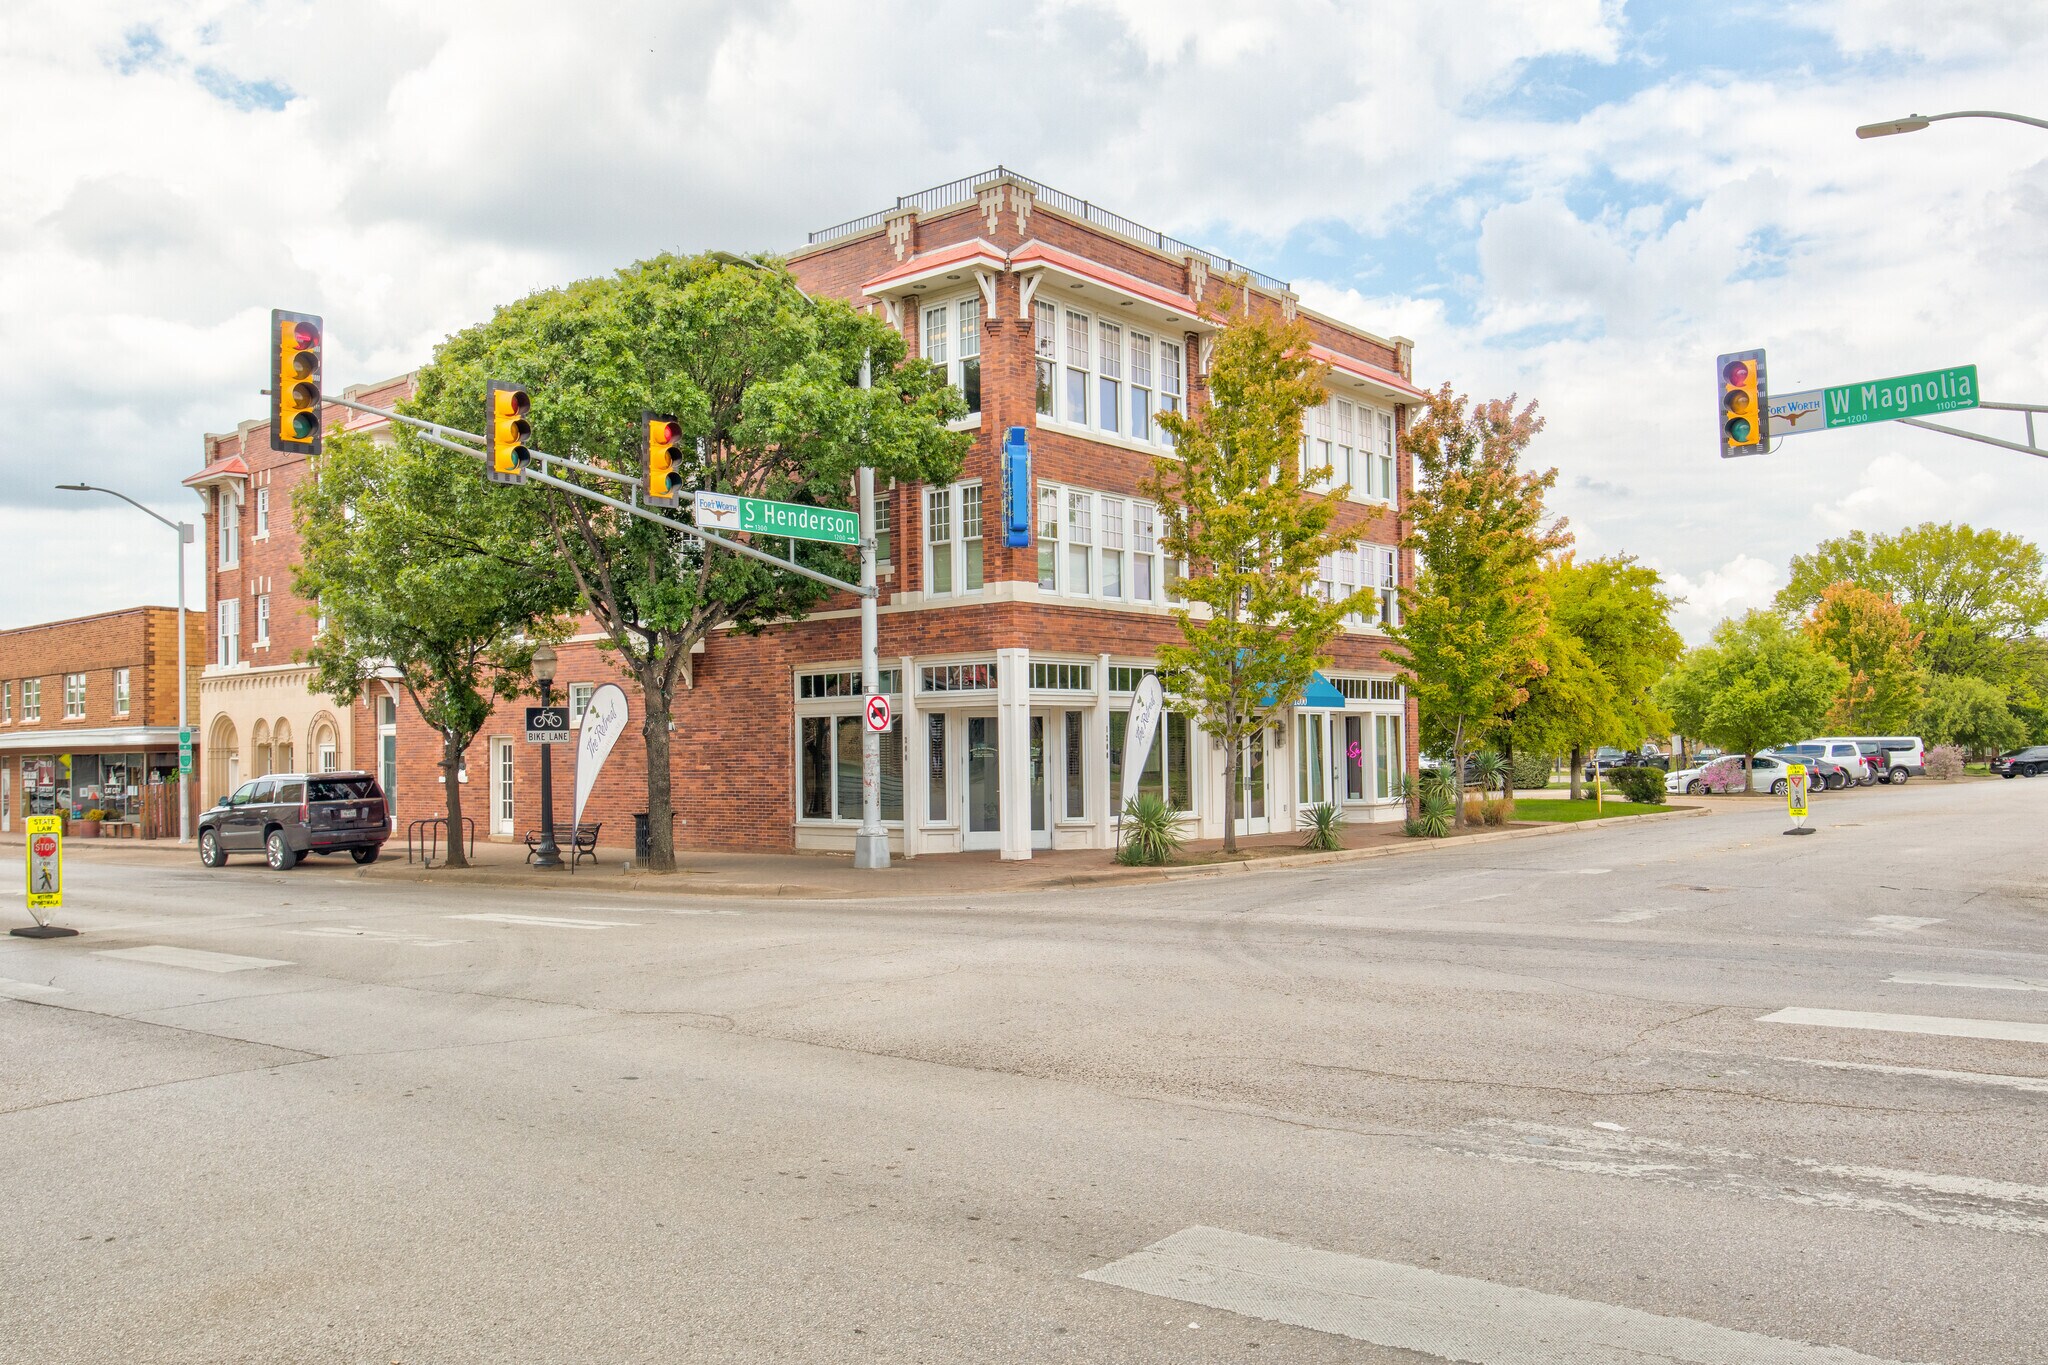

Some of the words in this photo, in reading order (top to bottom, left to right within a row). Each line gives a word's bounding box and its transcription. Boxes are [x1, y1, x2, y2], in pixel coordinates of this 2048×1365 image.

[1830, 389, 1850, 415] W
[1861, 372, 1971, 412] Magnolia
[1788, 400, 1820, 412] WORTH
[1936, 400, 1957, 410] 1100
[1847, 413, 1868, 424] 1200
[745, 501, 755, 522] S
[764, 504, 854, 535] Henderson
[755, 524, 768, 532] 1300
[586, 736, 599, 760] The
[594, 699, 617, 743] Retreat
[528, 732, 546, 741] BIKE
[549, 732, 568, 741] LANE
[34, 818, 55, 826] STATE
[35, 842, 56, 852] STOP
